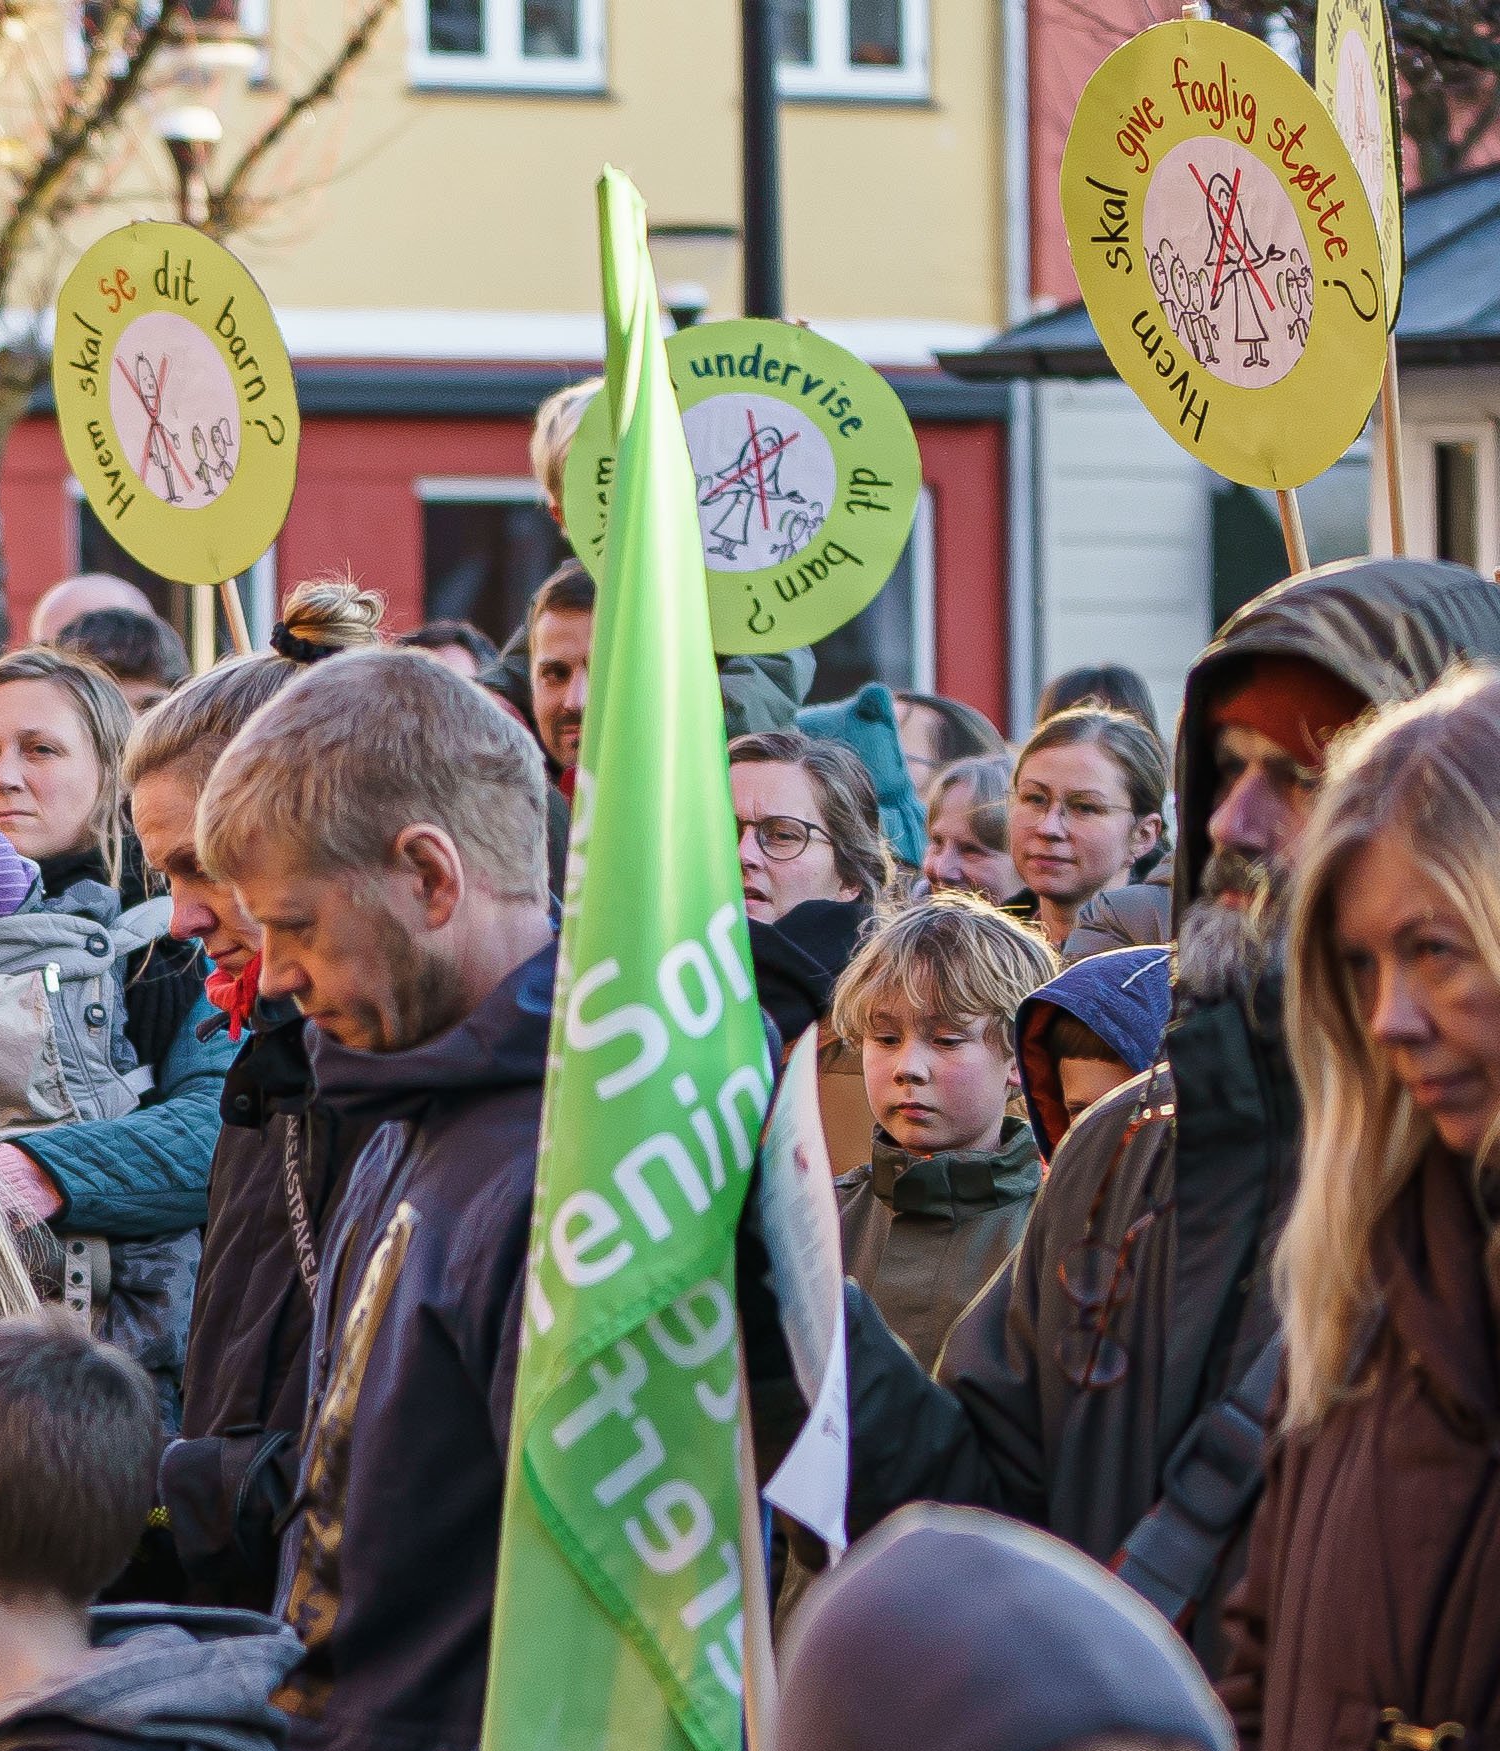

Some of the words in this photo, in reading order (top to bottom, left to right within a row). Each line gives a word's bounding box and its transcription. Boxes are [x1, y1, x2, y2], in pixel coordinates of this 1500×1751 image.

[1116, 97, 1164, 174] give
[1172, 57, 1256, 145] faglig
[1085, 176, 1133, 274] skal
[99, 267, 137, 314] se
[155, 250, 199, 306] dit
[70, 312, 103, 396] skal
[1131, 309, 1209, 443] Hvem
[86, 420, 135, 520] Hvem
[691, 343, 863, 438] undervise
[846, 467, 893, 515] dit
